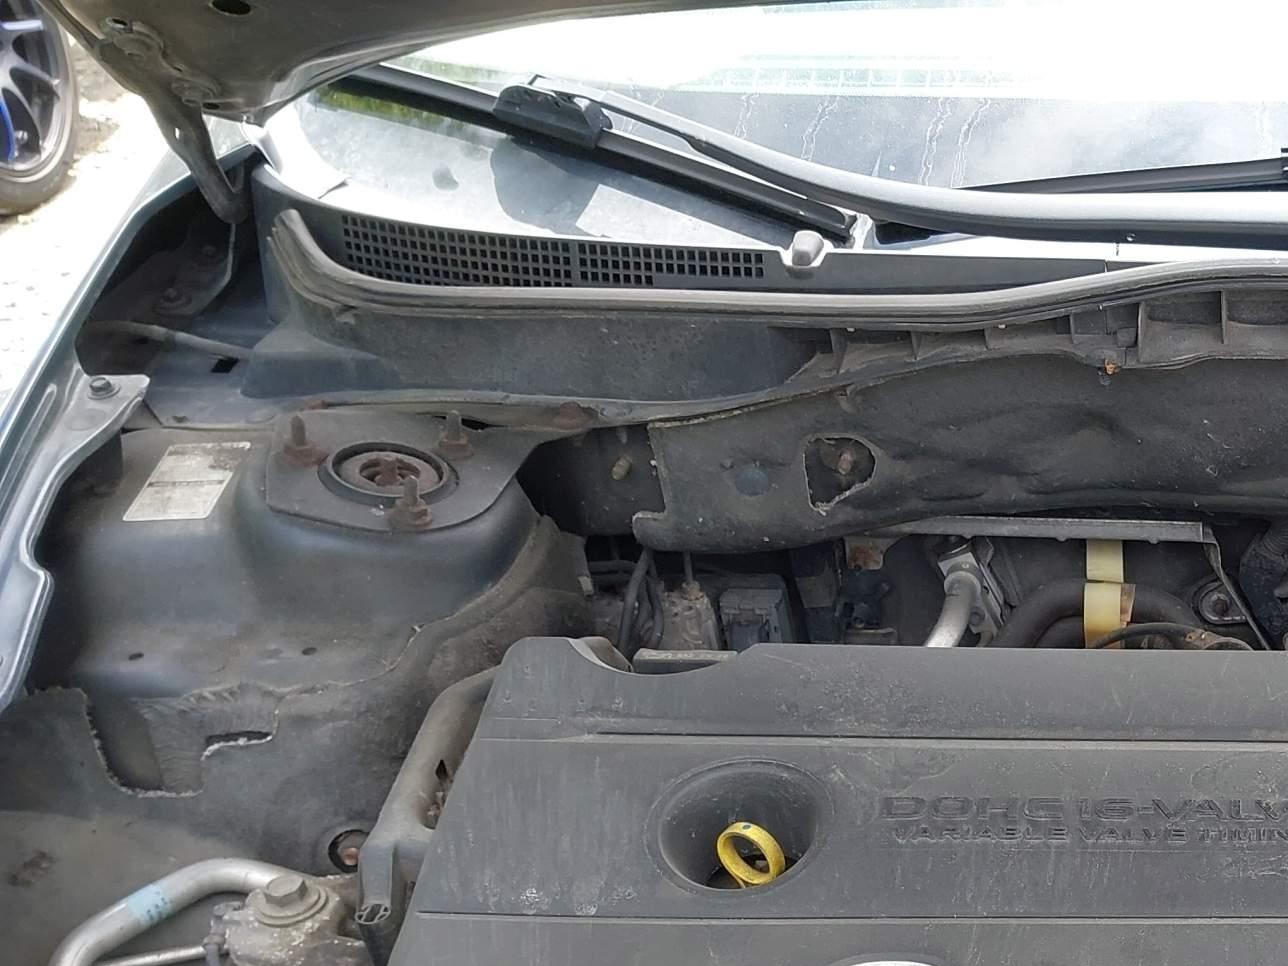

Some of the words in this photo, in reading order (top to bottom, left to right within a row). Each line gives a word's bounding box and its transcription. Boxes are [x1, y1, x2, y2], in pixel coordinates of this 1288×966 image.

[880, 797, 1065, 821] DOHC
[895, 825, 1070, 843] VARIABLE
[1079, 826, 1188, 843] VALVE
